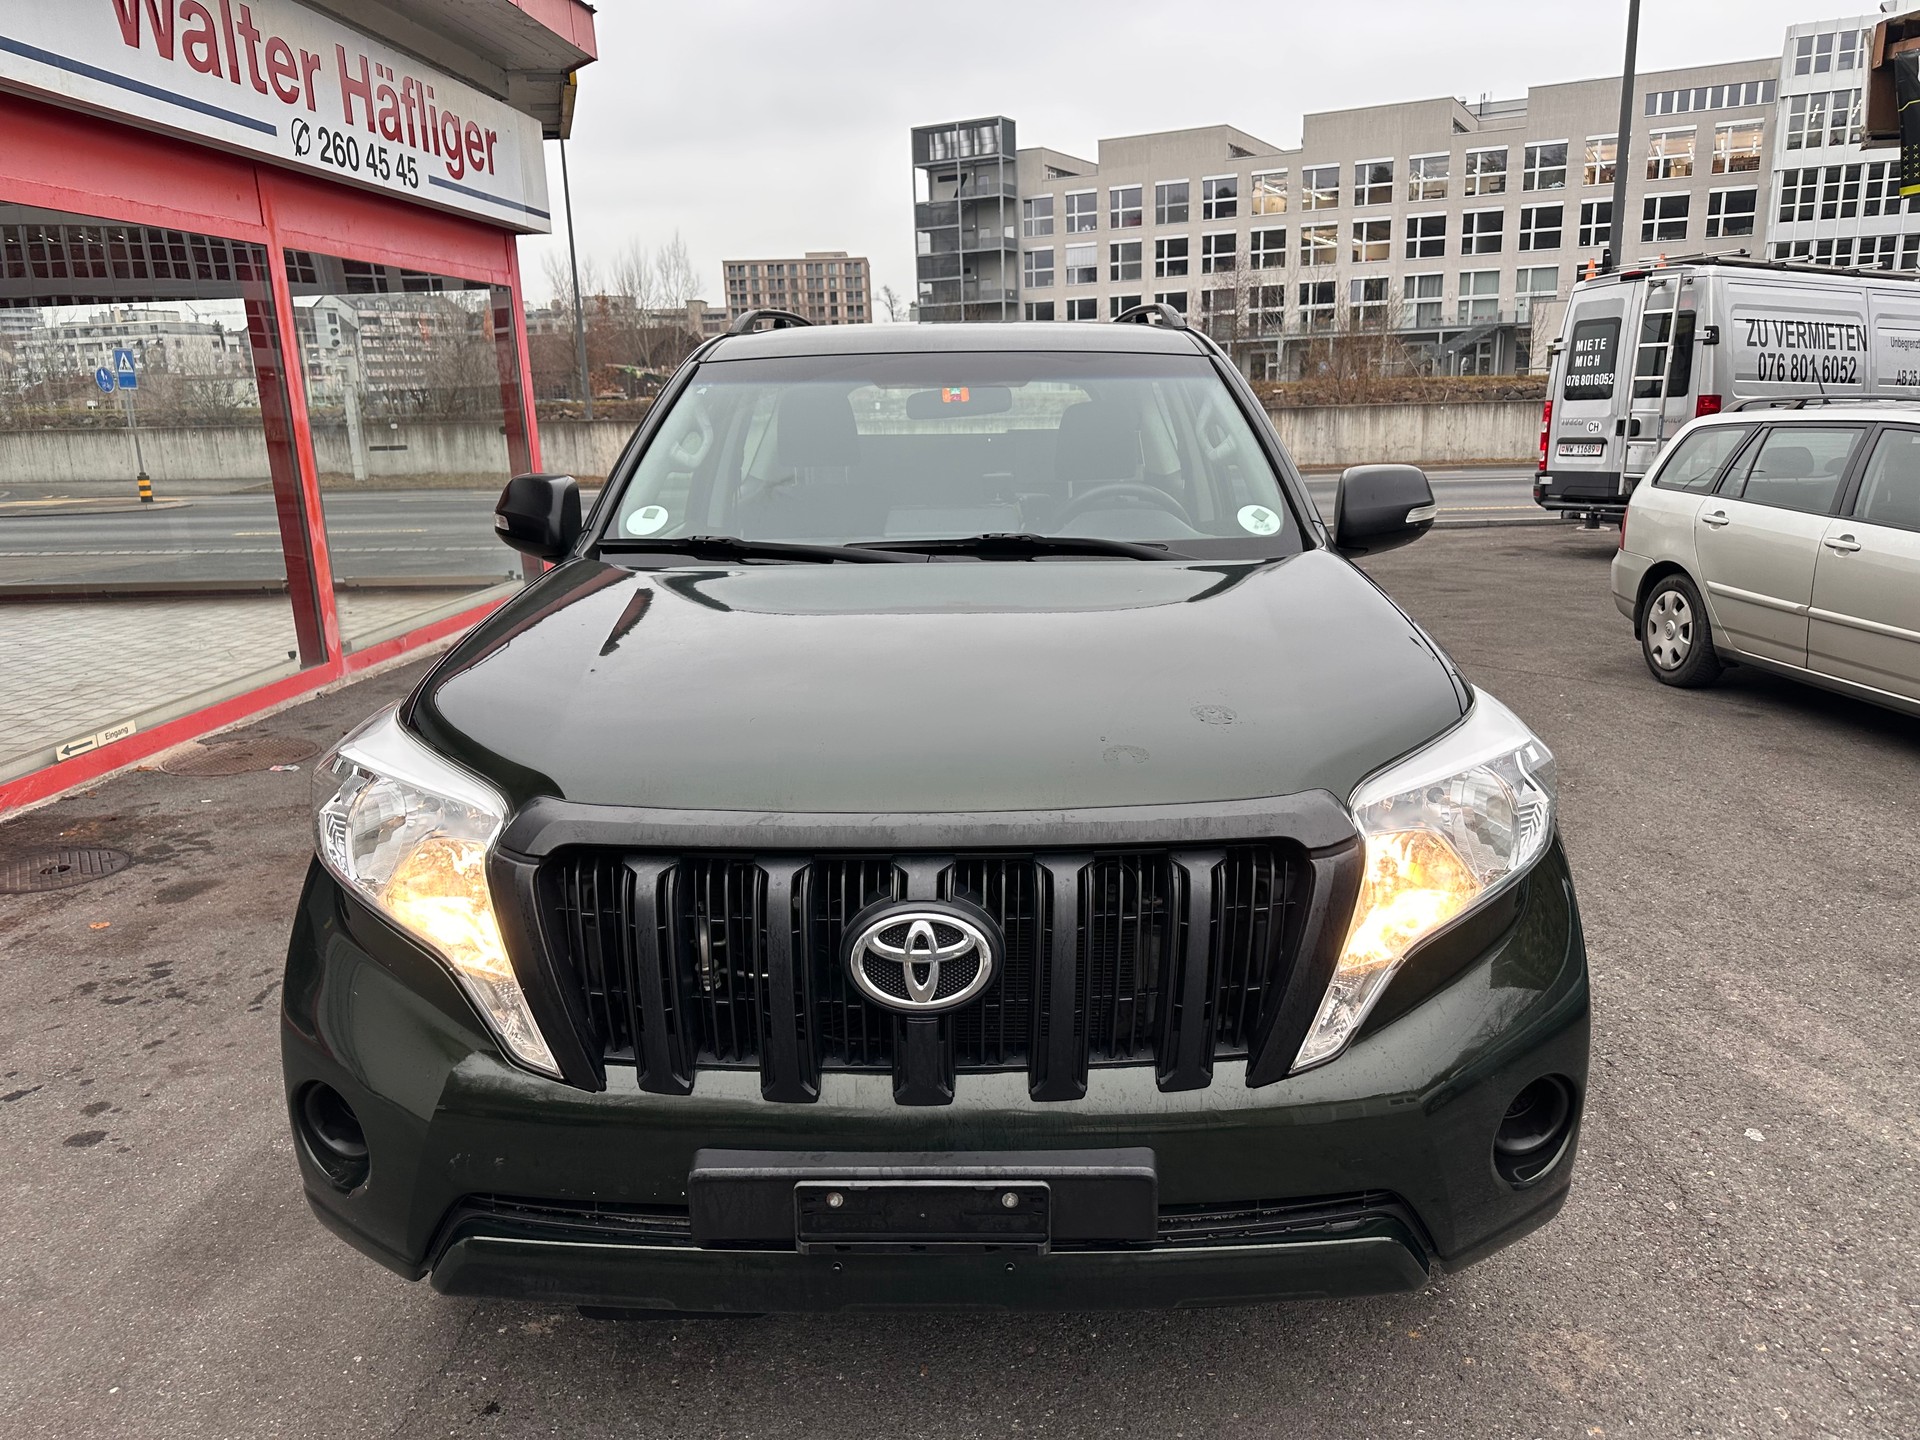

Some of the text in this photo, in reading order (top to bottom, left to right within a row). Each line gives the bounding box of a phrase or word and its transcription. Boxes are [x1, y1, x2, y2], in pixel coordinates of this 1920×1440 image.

[112, 0, 498, 180] Walter Häfliger
[317, 126, 419, 188] 260 45 45
[1745, 319, 1868, 351] ZU VERMIETEN
[1575, 337, 1607, 352] MIETE
[1574, 354, 1601, 367] MICH
[1758, 352, 1857, 384] 076 801 6052
[1895, 370, 1907, 386] AB
[1908, 370, 1918, 386] 25
[1588, 422, 1600, 432] CH
[104, 726, 129, 740] Eingang
